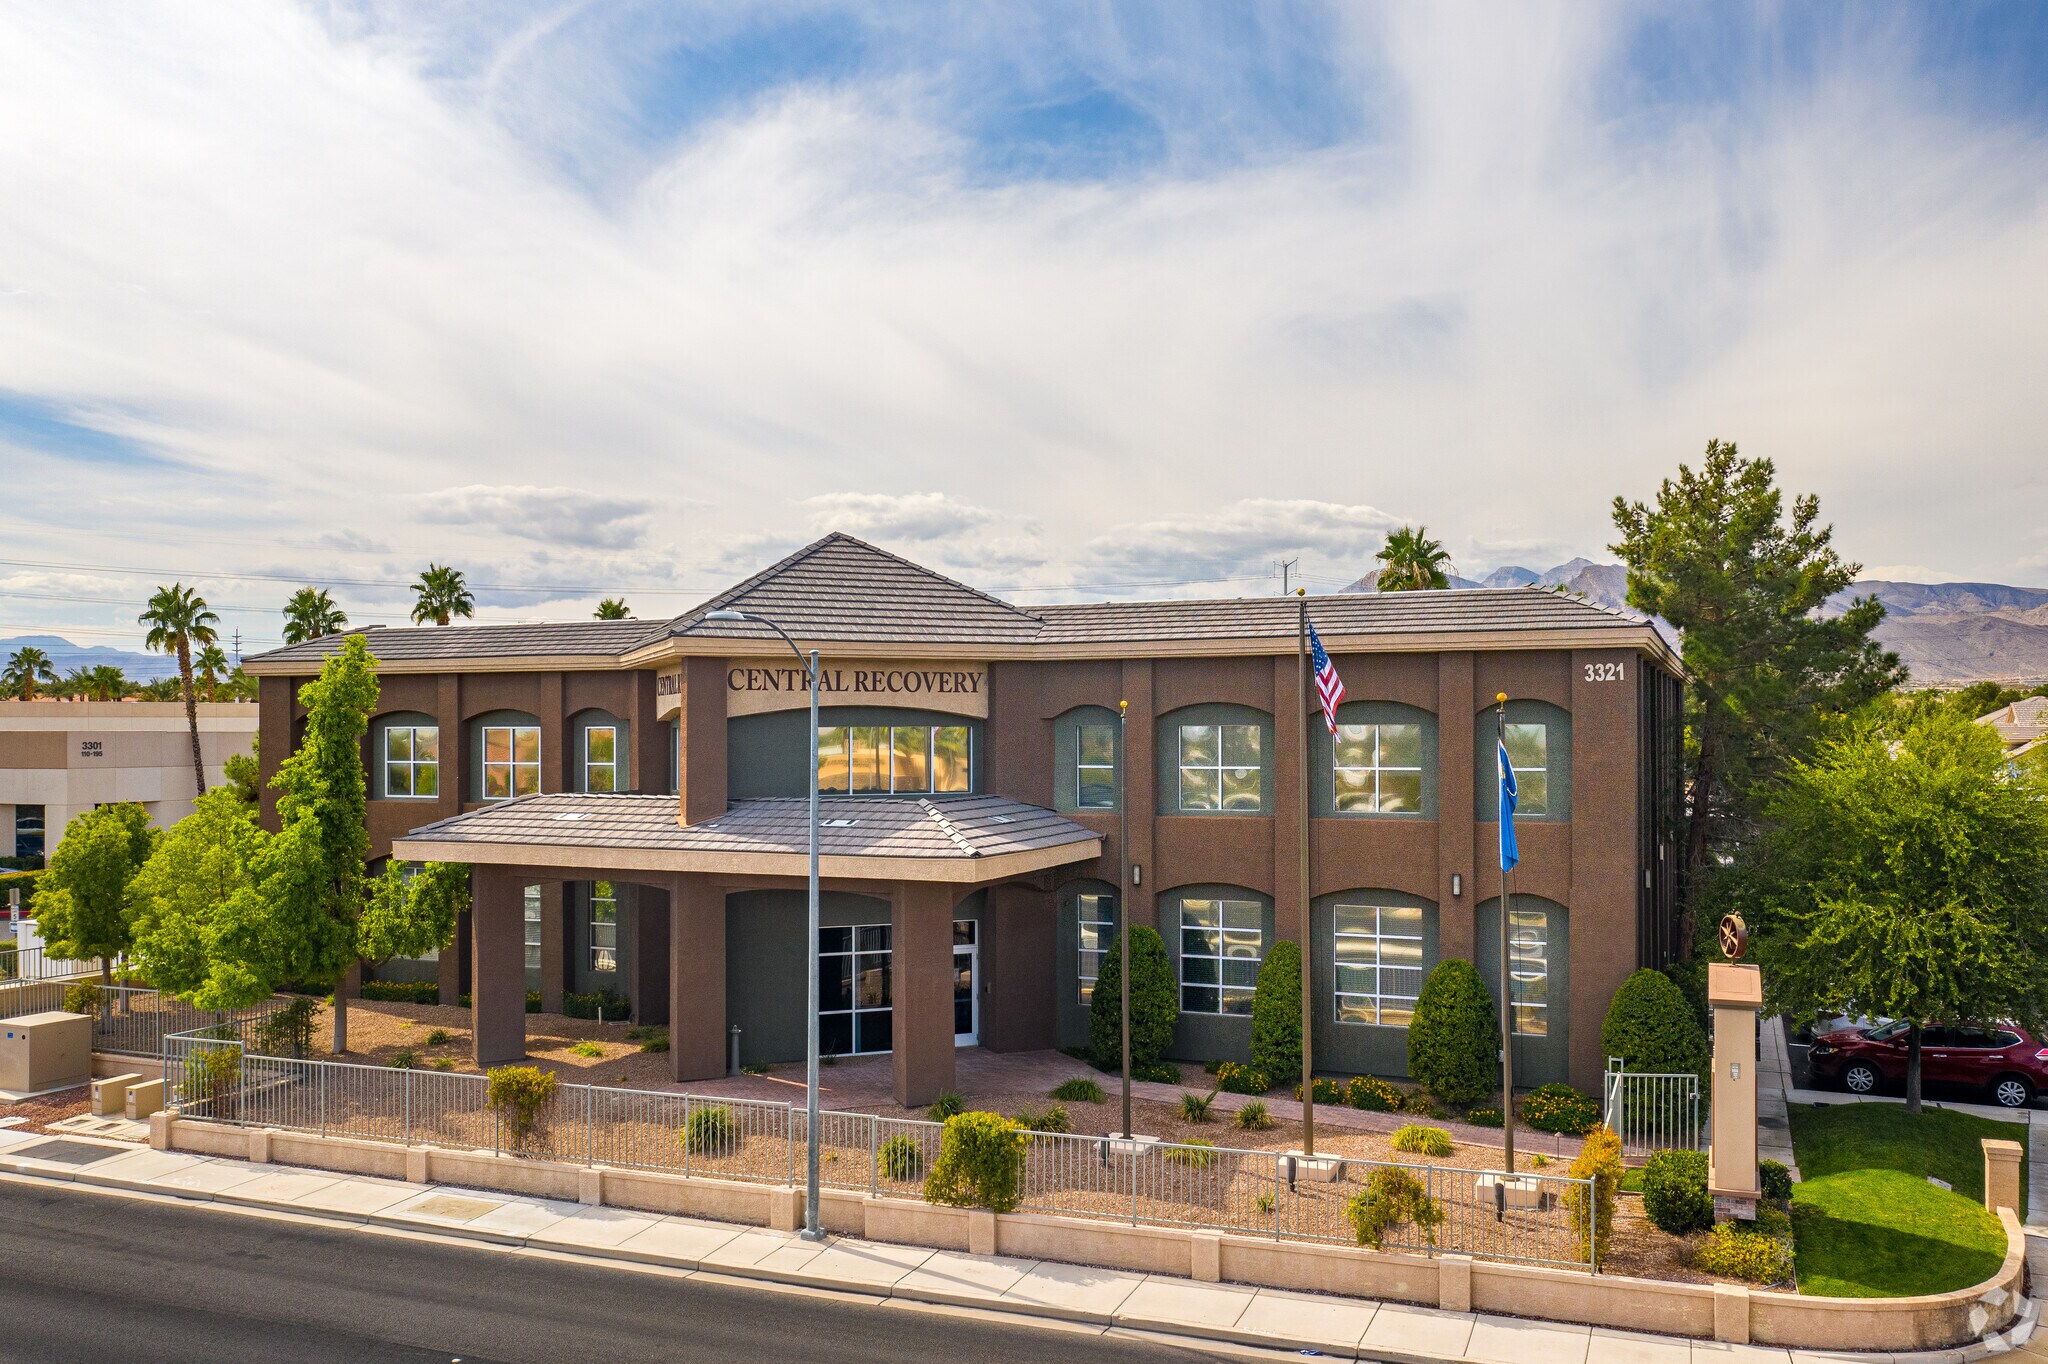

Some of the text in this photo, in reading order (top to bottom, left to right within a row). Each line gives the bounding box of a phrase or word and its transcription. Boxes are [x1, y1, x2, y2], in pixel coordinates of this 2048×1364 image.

[853, 670, 983, 693] RECOVERY
[1584, 662, 1625, 682] 3321
[82, 741, 102, 750] 3301
